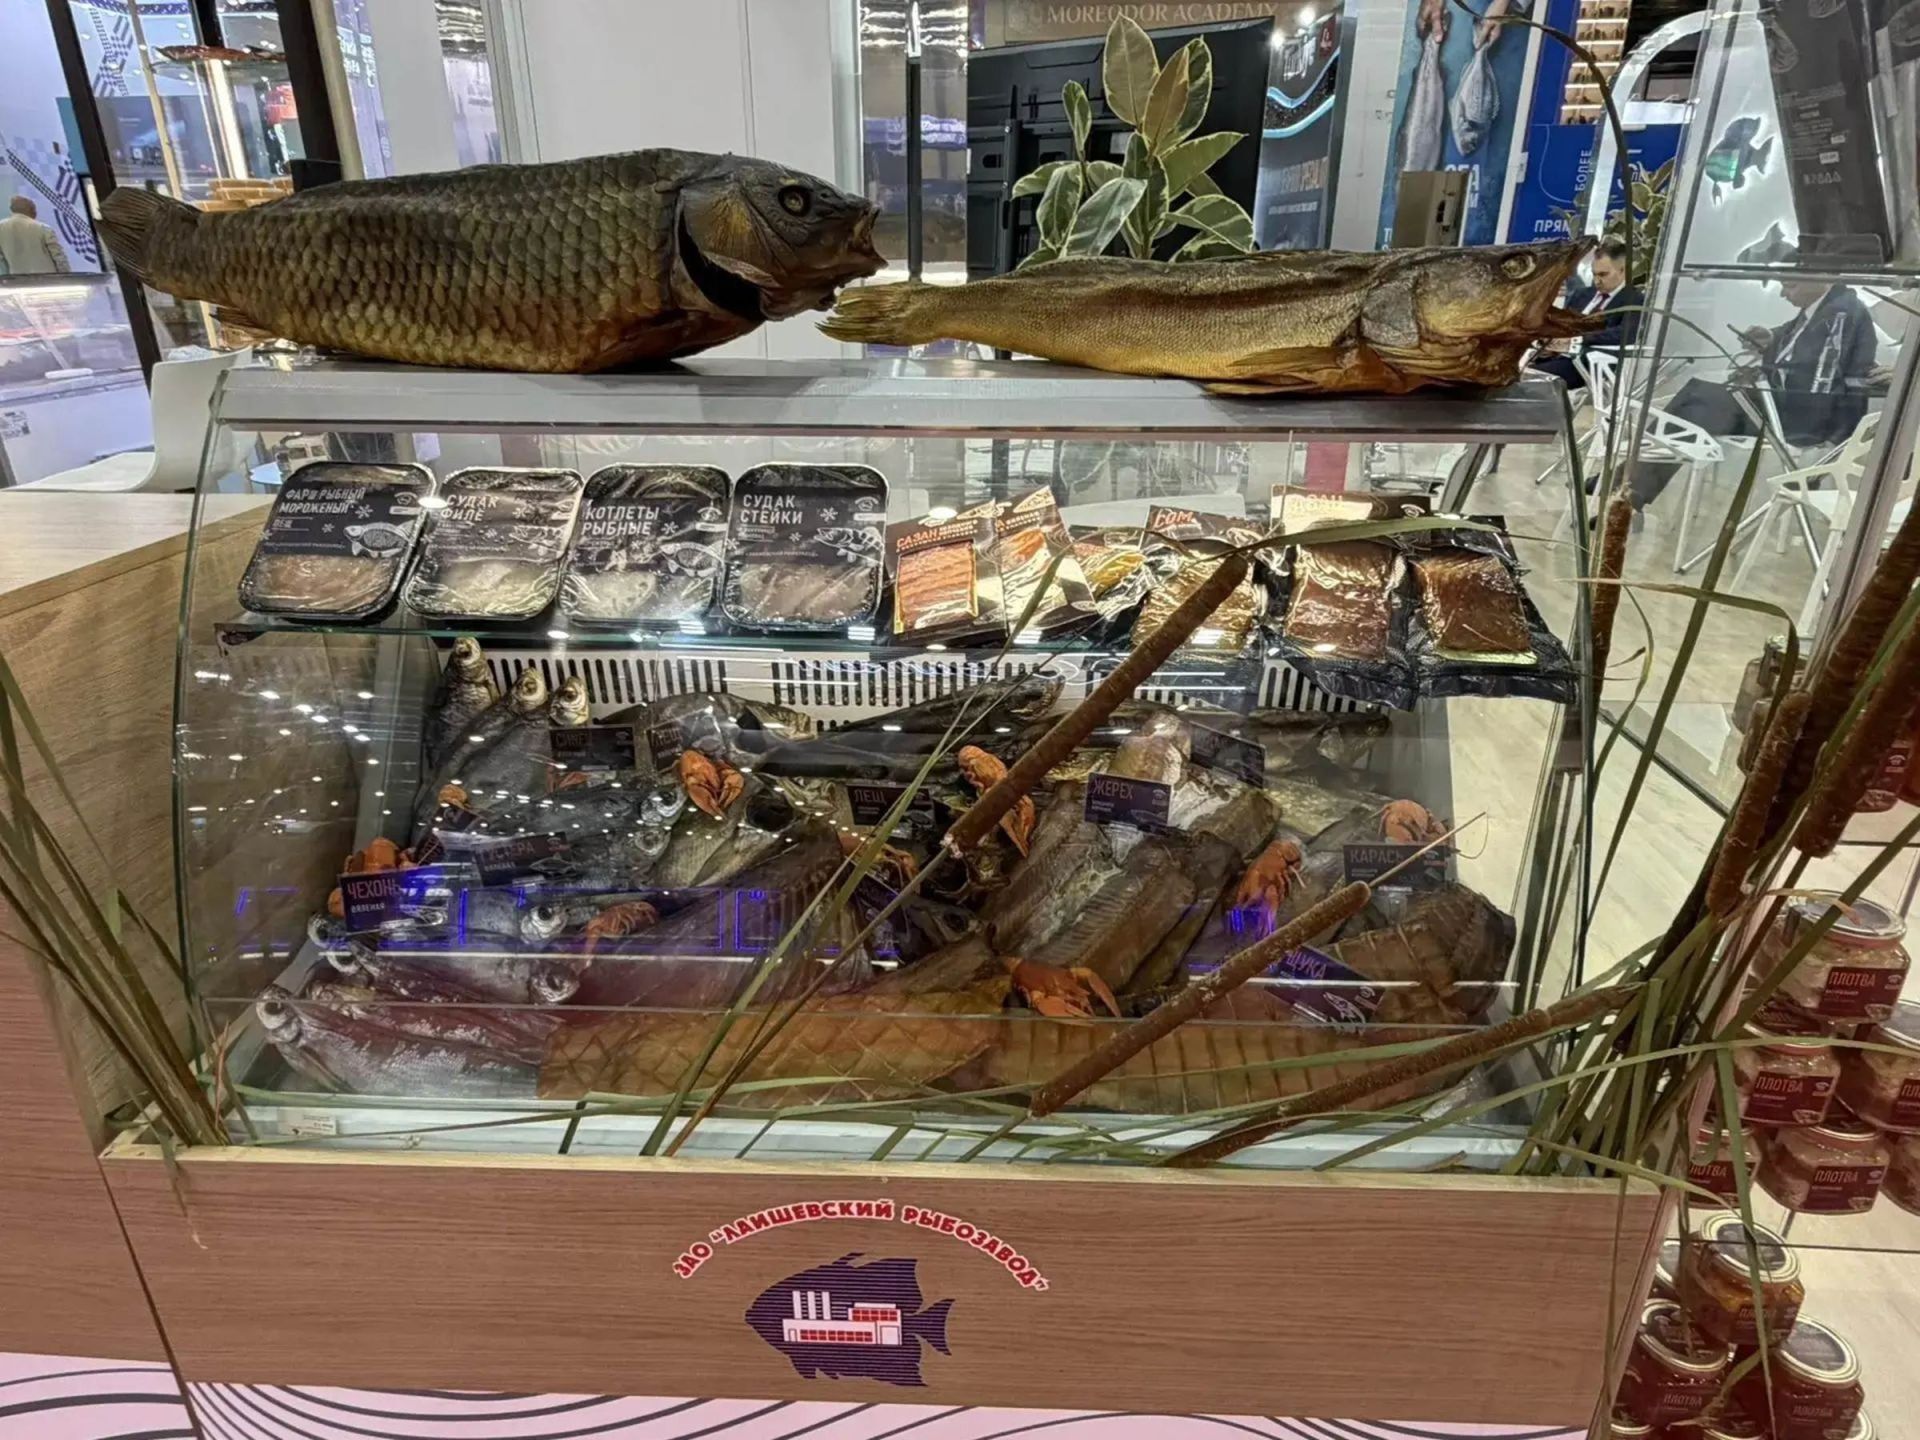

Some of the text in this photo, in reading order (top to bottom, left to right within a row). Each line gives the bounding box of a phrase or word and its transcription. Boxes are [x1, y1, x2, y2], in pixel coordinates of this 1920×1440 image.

[1047, 4, 1280, 24] MOREODOR ACADEMY
[1574, 150, 1592, 192] БОЛЕЕ
[285, 487, 367, 500] ФАРШ РЫБНЫЙ
[446, 493, 500, 509] СУДАК
[742, 494, 797, 510] СУДАК
[279, 501, 352, 513] МОРОЖЕНЫЙ
[439, 507, 486, 522] ФИЛЕ
[584, 505, 660, 521] КОТЛЕТЫ
[739, 508, 803, 525] СТЕЙКИ
[581, 521, 653, 536] РЫБНЫЕ
[896, 529, 938, 548] САЗАН
[854, 790, 887, 805] ЛЕЩ
[1093, 778, 1134, 800] ЖЕРЕХ
[346, 875, 401, 900] ЧЕХОНЬ
[1285, 951, 1328, 980] ЩУКА
[1829, 971, 1877, 988] ПЛОТВА
[1756, 1076, 1804, 1093] ПЛОТВА
[1814, 1170, 1859, 1183] ПЛОТВА
[673, 1242, 712, 1278] ЗАО
